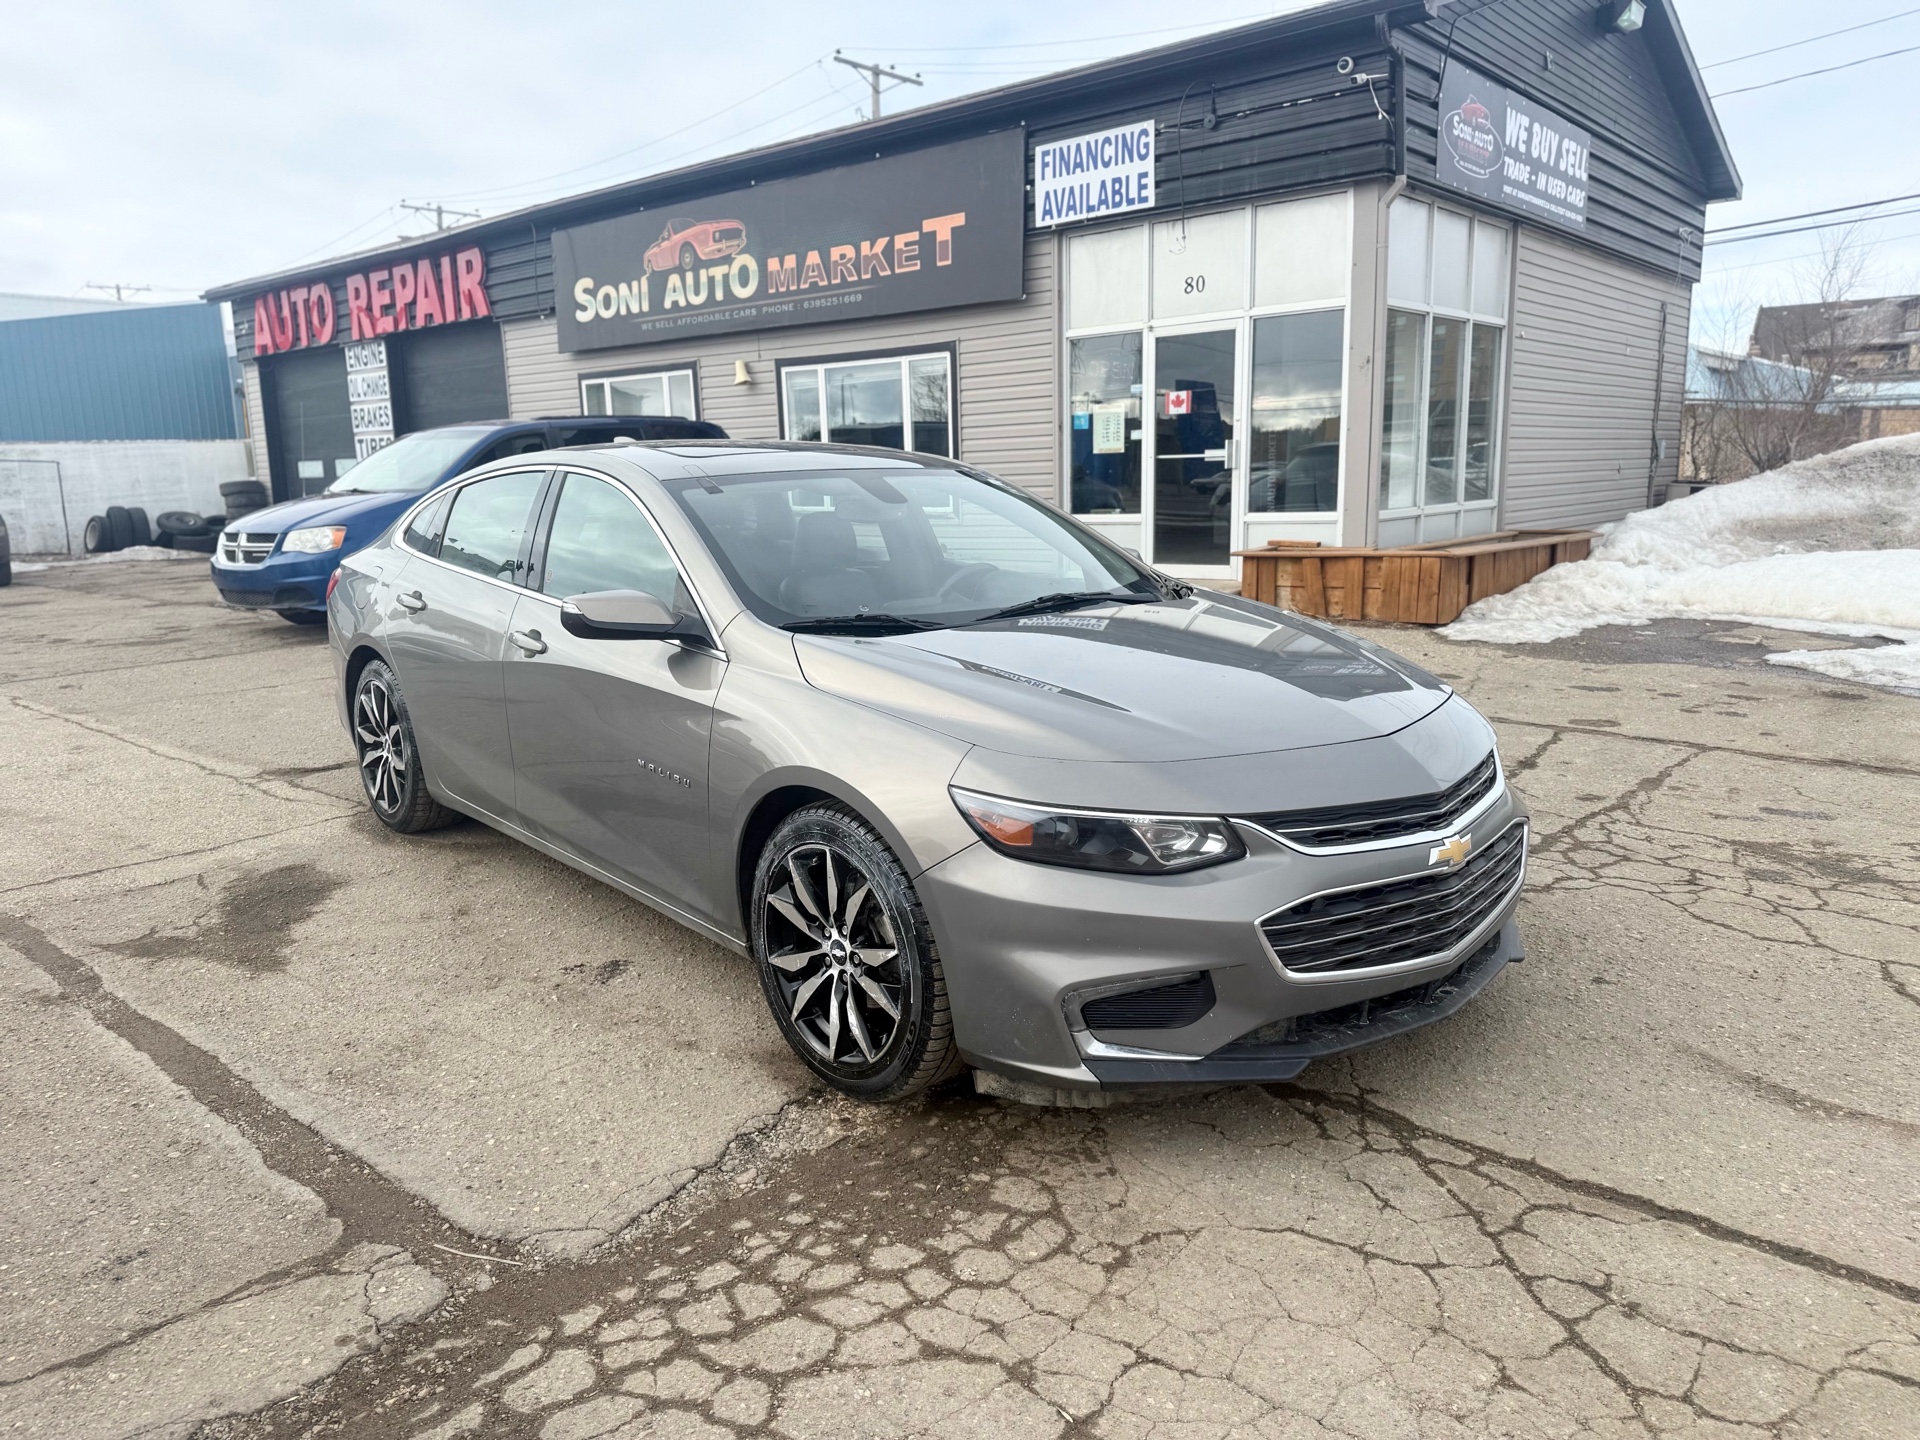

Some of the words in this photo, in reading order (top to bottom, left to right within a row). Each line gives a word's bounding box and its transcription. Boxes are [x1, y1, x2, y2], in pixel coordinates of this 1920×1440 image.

[1452, 115, 1472, 141] SONI
[1473, 130, 1494, 152] AUTO
[1505, 106, 1530, 154] WE
[1531, 122, 1559, 167] BUY
[1559, 138, 1588, 182] SELL
[1041, 127, 1150, 181] FINANCING
[1041, 171, 1149, 222] AVAILABLE
[1503, 156, 1531, 185] TRADE
[1536, 172, 1547, 191] IN
[1547, 176, 1566, 200] USED
[1567, 185, 1586, 208] CARS
[573, 275, 650, 323] SONI
[663, 253, 760, 310] AUTO
[766, 212, 967, 294] MARKET
[1184, 275, 1206, 295] 80
[254, 282, 336, 355] AUTO
[346, 245, 492, 340] REPAIR
[640, 322, 653, 331] WE
[655, 319, 675, 329] SELL
[677, 311, 731, 326] AFFORDABLE
[733, 308, 757, 318] CARS
[762, 303, 795, 314] PHONE
[803, 293, 863, 309] 6395251669
[348, 343, 385, 369] ENGINE
[349, 379, 361, 399] OIL
[362, 375, 388, 398] CHANGE
[352, 405, 390, 430] BRAKES
[637, 758, 691, 788] MALIBU
